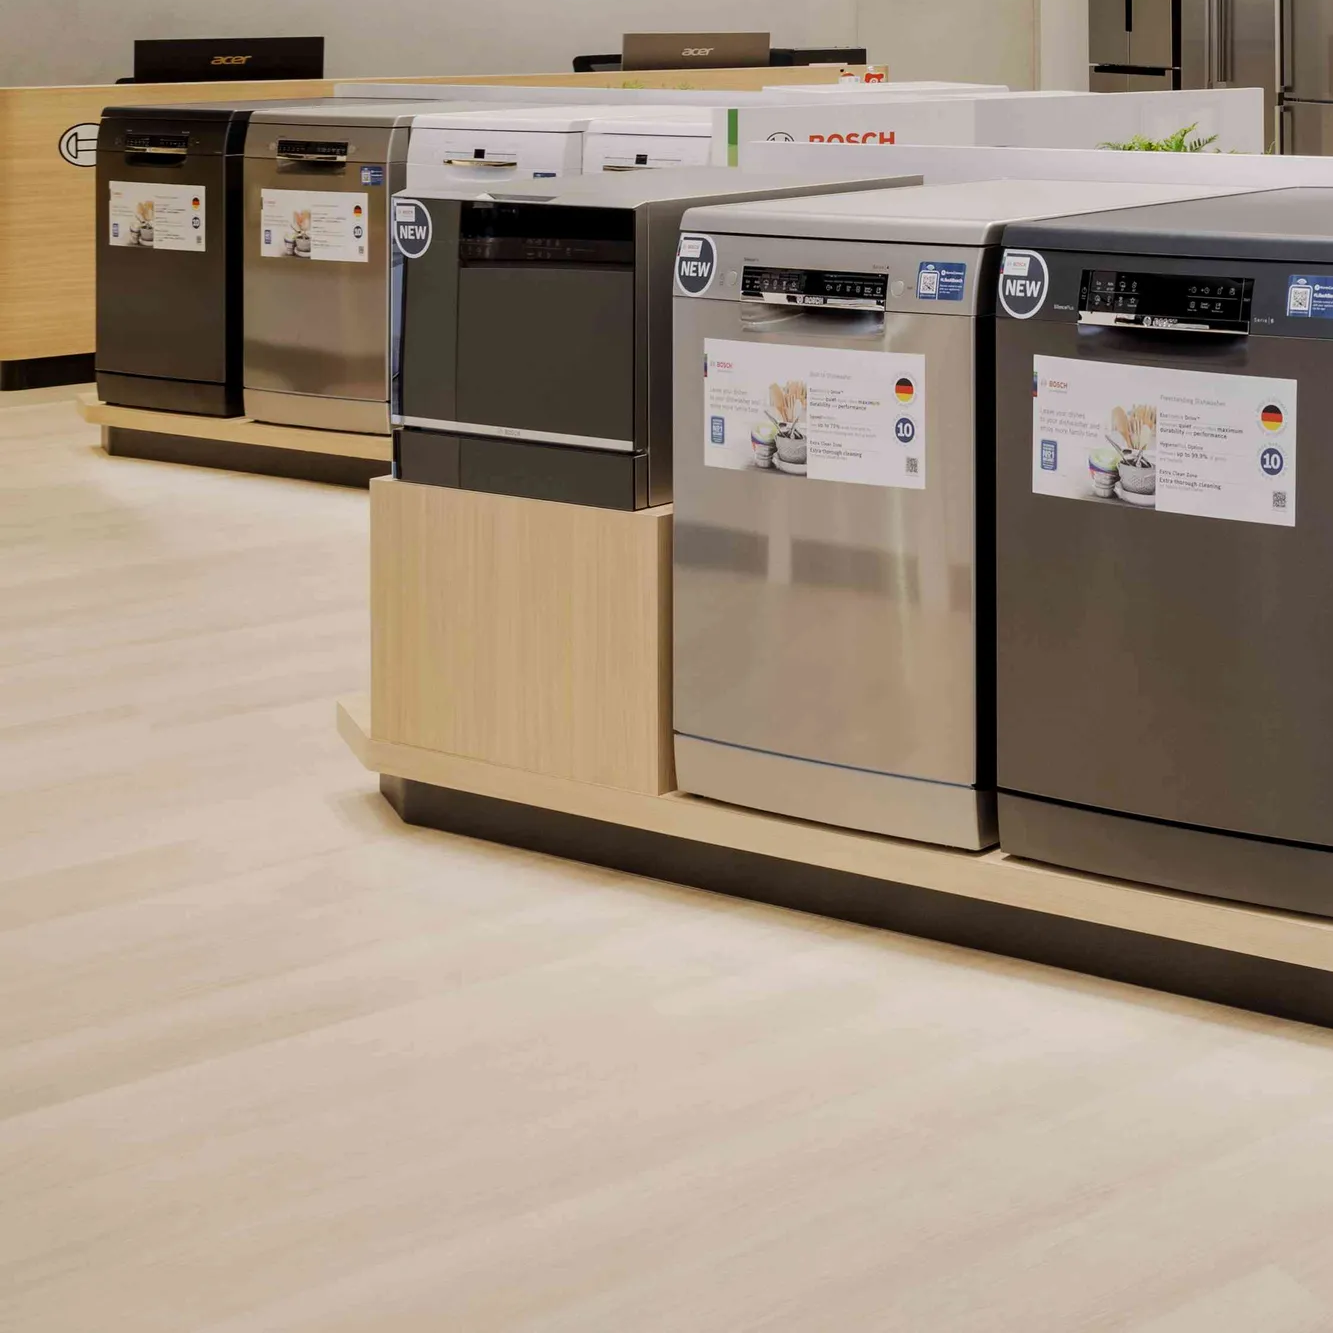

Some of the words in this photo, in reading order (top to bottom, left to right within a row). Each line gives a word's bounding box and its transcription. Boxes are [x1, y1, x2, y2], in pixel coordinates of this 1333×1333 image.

[681, 47, 715, 56] acer
[211, 55, 253, 65] acer
[400, 225, 427, 240] NEW
[681, 261, 711, 277] NEW
[1005, 279, 1042, 298] NEW
[804, 295, 824, 304] BOSCH
[1049, 380, 1068, 389] BOSCH
[897, 422, 913, 438] 10
[1263, 453, 1281, 470] 10
[1199, 482, 1222, 490] cleaning
